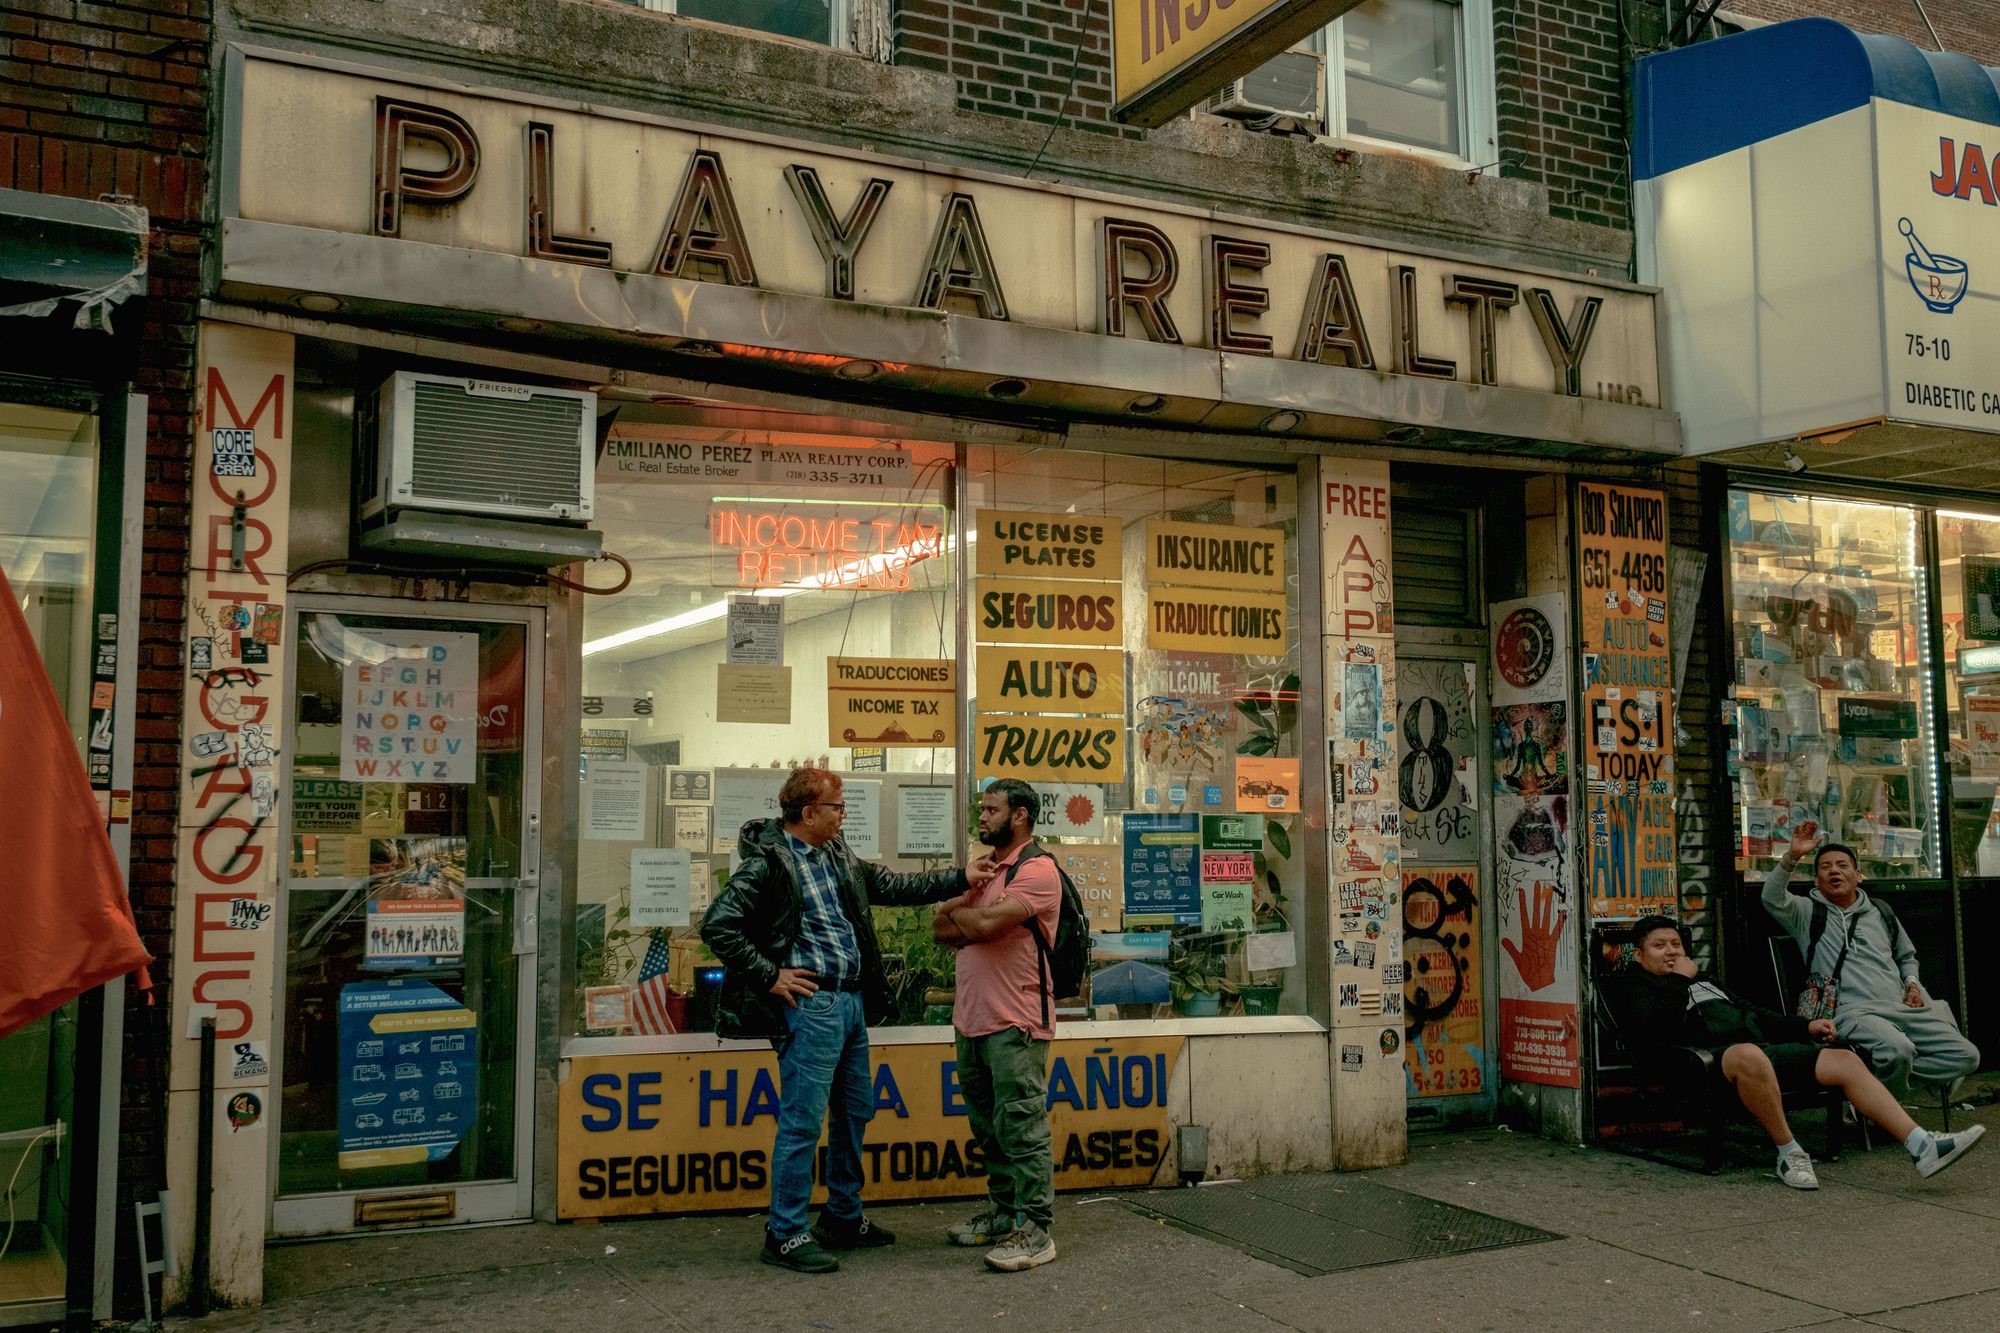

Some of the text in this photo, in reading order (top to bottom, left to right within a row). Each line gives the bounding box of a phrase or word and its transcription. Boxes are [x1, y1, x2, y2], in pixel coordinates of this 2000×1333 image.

[372, 95, 1009, 321] PLAYA
[1096, 217, 1603, 397] REALTY
[1905, 334, 1950, 361] 75-10
[479, 383, 529, 394] FRIEDRICH
[1906, 382, 1976, 414] DIABETIC
[214, 430, 253, 453] CORE
[607, 440, 752, 464] EMILIANO PEREZ
[214, 464, 256, 476] CREW
[618, 460, 740, 478] Lic. Real Estate Broker
[761, 450, 909, 469] PLAYA REALTY CORP.
[810, 470, 885, 485] 335-3711
[1327, 482, 1386, 519] FREE
[1610, 489, 1663, 542] SHAPIRO
[717, 511, 942, 559] INCOME TAX
[994, 521, 1104, 545] LICENSE
[1004, 545, 1096, 568] PLATES
[1157, 535, 1275, 576] INSURANCE
[739, 550, 912, 590] RETURNS
[732, 604, 780, 613] INCOME TAX
[983, 591, 1115, 631] SEGUROS
[1154, 601, 1282, 640] TRADUCCIONES
[1603, 617, 1649, 650] AUTO
[837, 665, 949, 682] TRADUCCIONES
[1000, 660, 1097, 699] AUTO
[1146, 670, 1221, 694] WELCOME
[1590, 654, 1669, 688] NSURANCE
[848, 698, 940, 715] INCOME TAX
[1843, 703, 1869, 718] Lyca
[982, 724, 1117, 770] TRUCKS
[1597, 752, 1664, 780] TODAY
[293, 782, 362, 798] PLEASE
[295, 801, 356, 811] WIPE YOUR
[318, 811, 361, 820] BEFORE
[1643, 797, 1671, 828] AGE
[1592, 795, 1639, 898] ANY
[1645, 833, 1673, 862] CAR
[1204, 862, 1252, 876] NEW YORK
[1641, 866, 1676, 897] DRIVER
[1212, 891, 1244, 899] Car Wash
[1341, 890, 1361, 900] WAS
[1341, 898, 1363, 909] HERE
[230, 918, 260, 930] 365
[581, 1064, 908, 1132] SE HAA
[579, 1150, 767, 1200] SEGUROS
